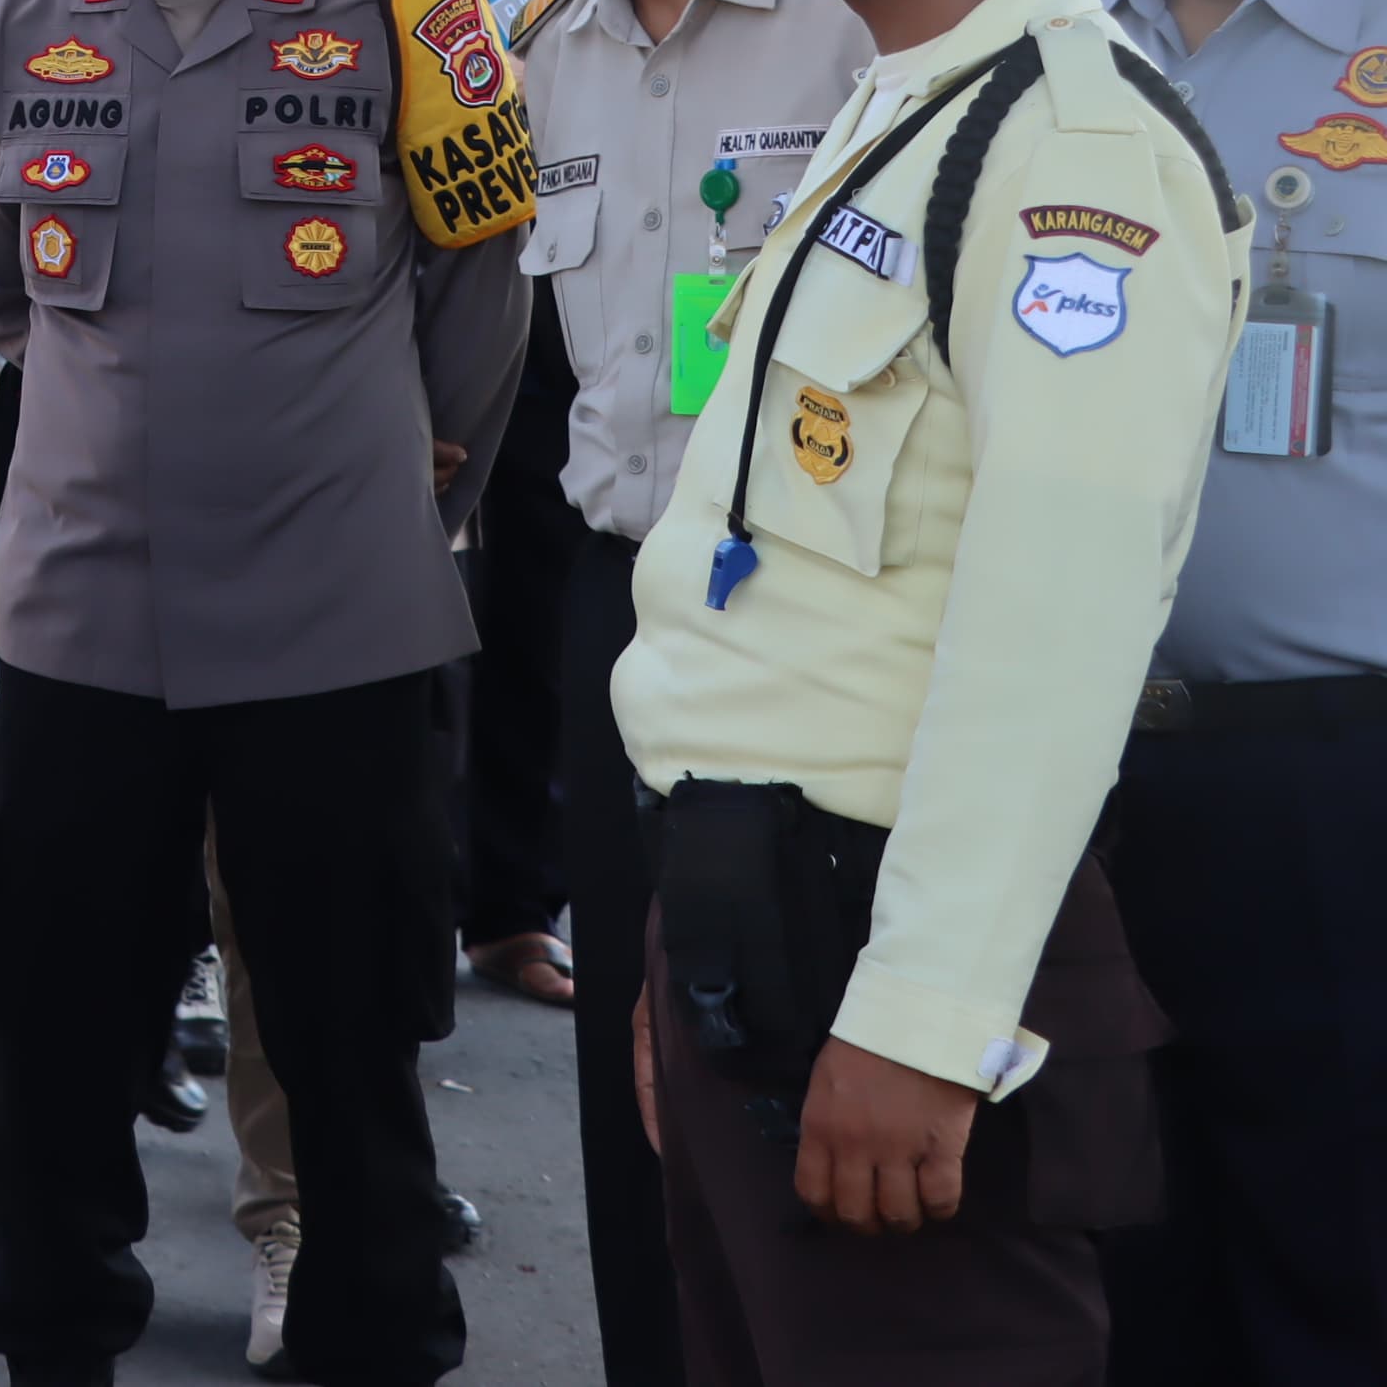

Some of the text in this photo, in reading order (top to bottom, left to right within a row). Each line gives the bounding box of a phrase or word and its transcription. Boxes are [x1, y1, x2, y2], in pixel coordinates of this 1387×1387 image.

[444, 20, 477, 46] BALI
[9, 99, 123, 131] AGUNG
[245, 94, 373, 129] POLRI
[720, 133, 756, 153] HEALTH
[823, 211, 881, 267] ATPA
[1030, 210, 1150, 250] KARANGASEM
[1055, 294, 1118, 318] pkss
